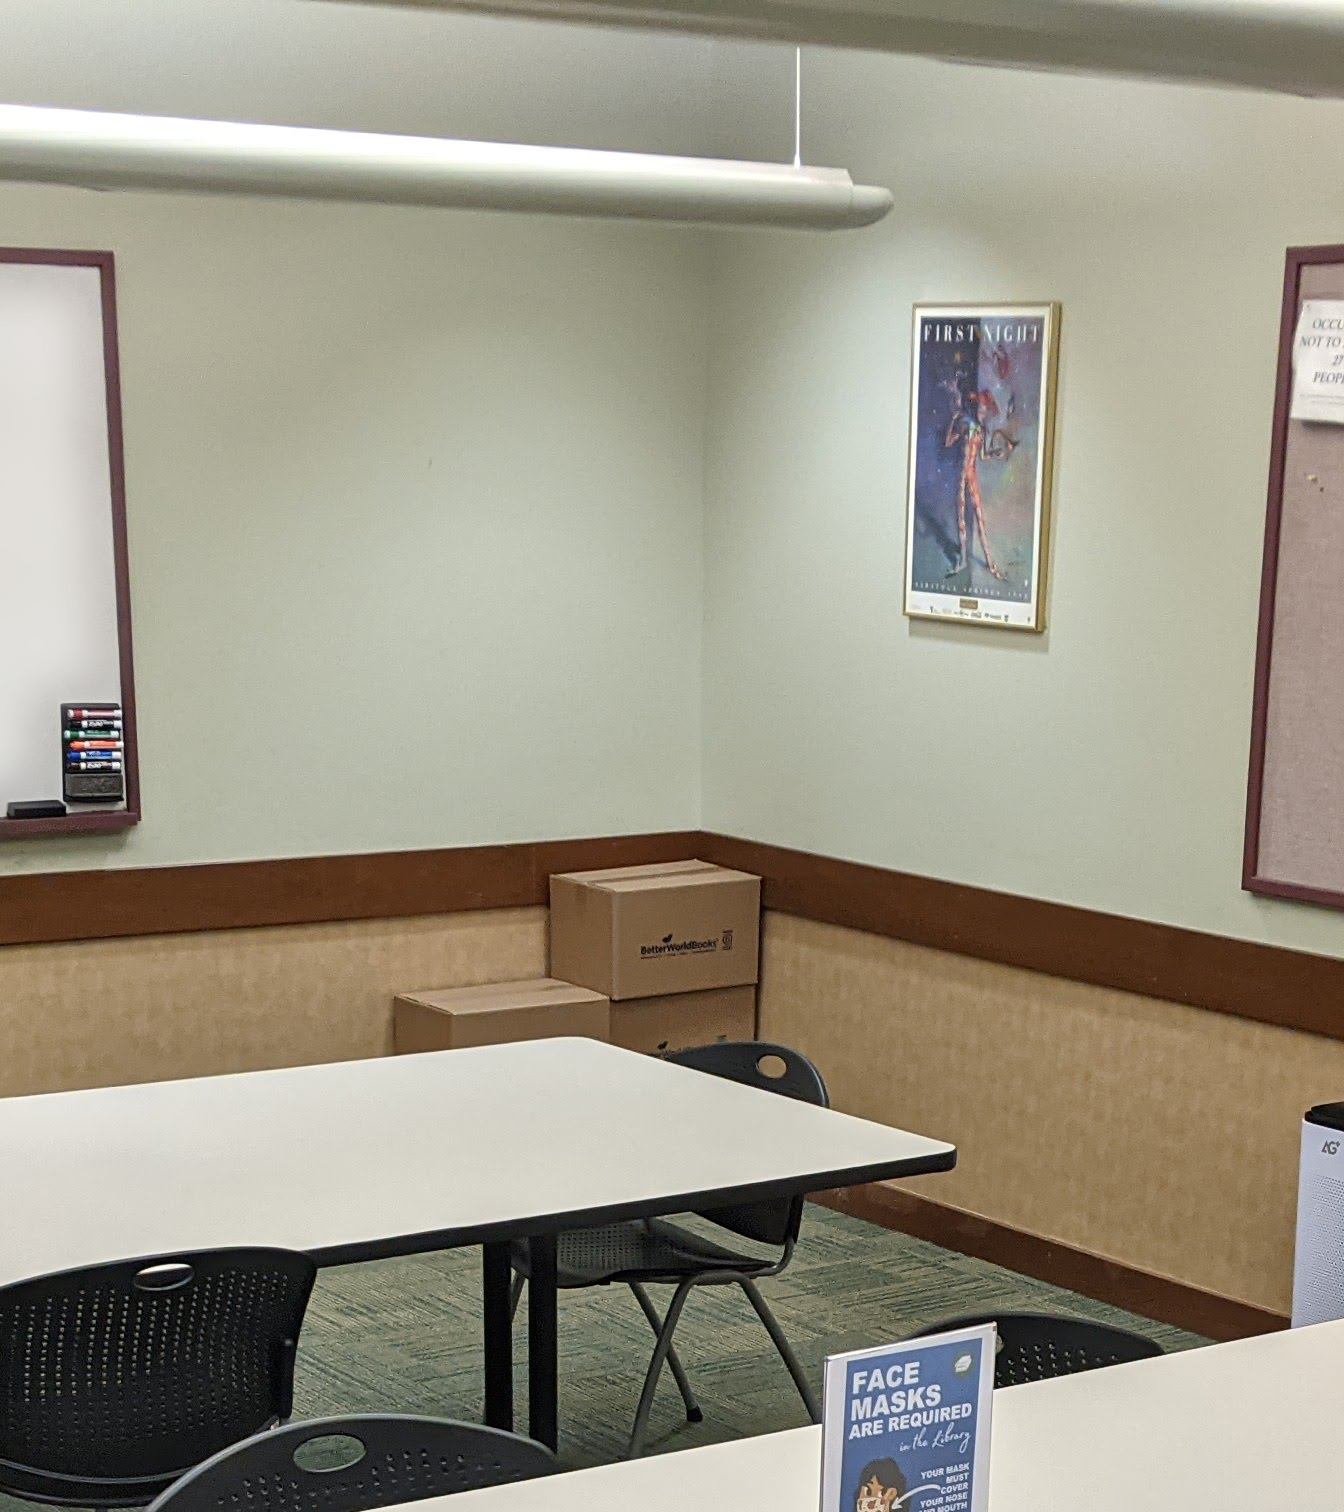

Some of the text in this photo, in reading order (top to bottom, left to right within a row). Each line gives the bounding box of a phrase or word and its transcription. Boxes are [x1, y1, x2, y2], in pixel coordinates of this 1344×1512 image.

[924, 324, 1039, 343] FIRST NIGHT
[1300, 336, 1323, 348] NOT
[1326, 336, 1341, 348] TO
[1332, 354, 1344, 366] 27
[640, 940, 716, 955] BetterWorldBooks
[852, 1361, 920, 1395] FACE
[850, 1384, 941, 1422] MASKS
[848, 1402, 972, 1440] ARE REQUIRED
[899, 1421, 971, 1453] in the Library
[920, 1462, 970, 1480] YOUR MASK
[945, 1472, 969, 1484] MUST
[940, 1482, 968, 1495] COVER
[920, 1491, 968, 1508] YOUR NOSE
